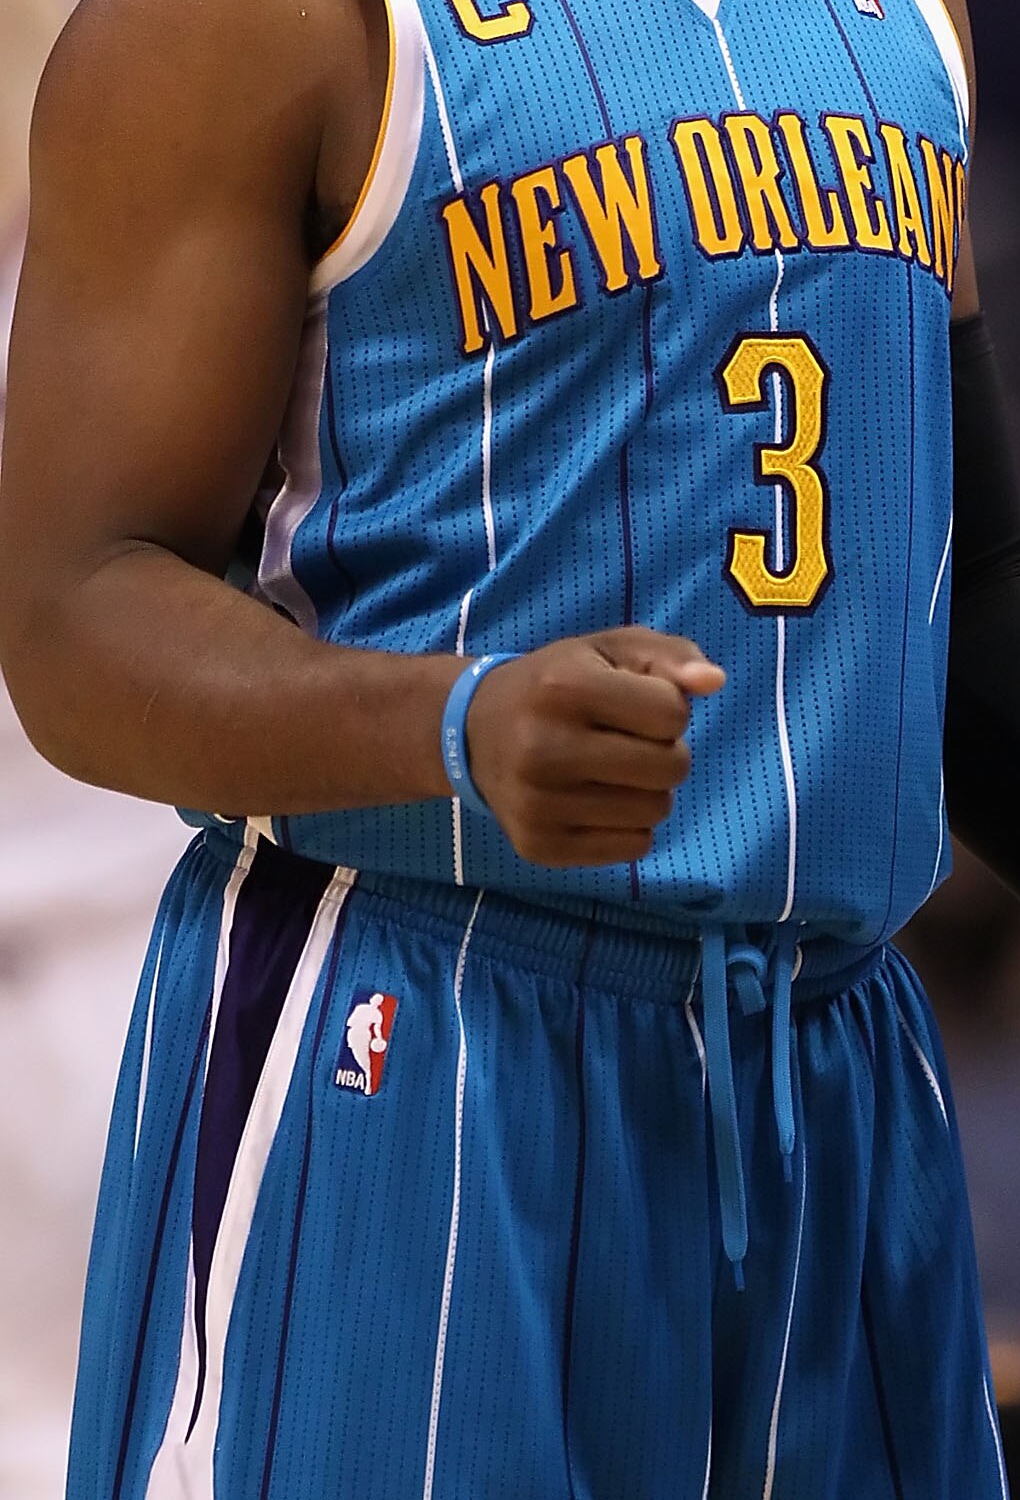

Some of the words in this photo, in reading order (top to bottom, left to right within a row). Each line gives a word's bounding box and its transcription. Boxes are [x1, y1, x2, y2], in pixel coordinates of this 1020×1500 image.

[442, 132, 665, 356] NEW
[711, 330, 836, 616] 3
[336, 1069, 365, 1090] NBA
